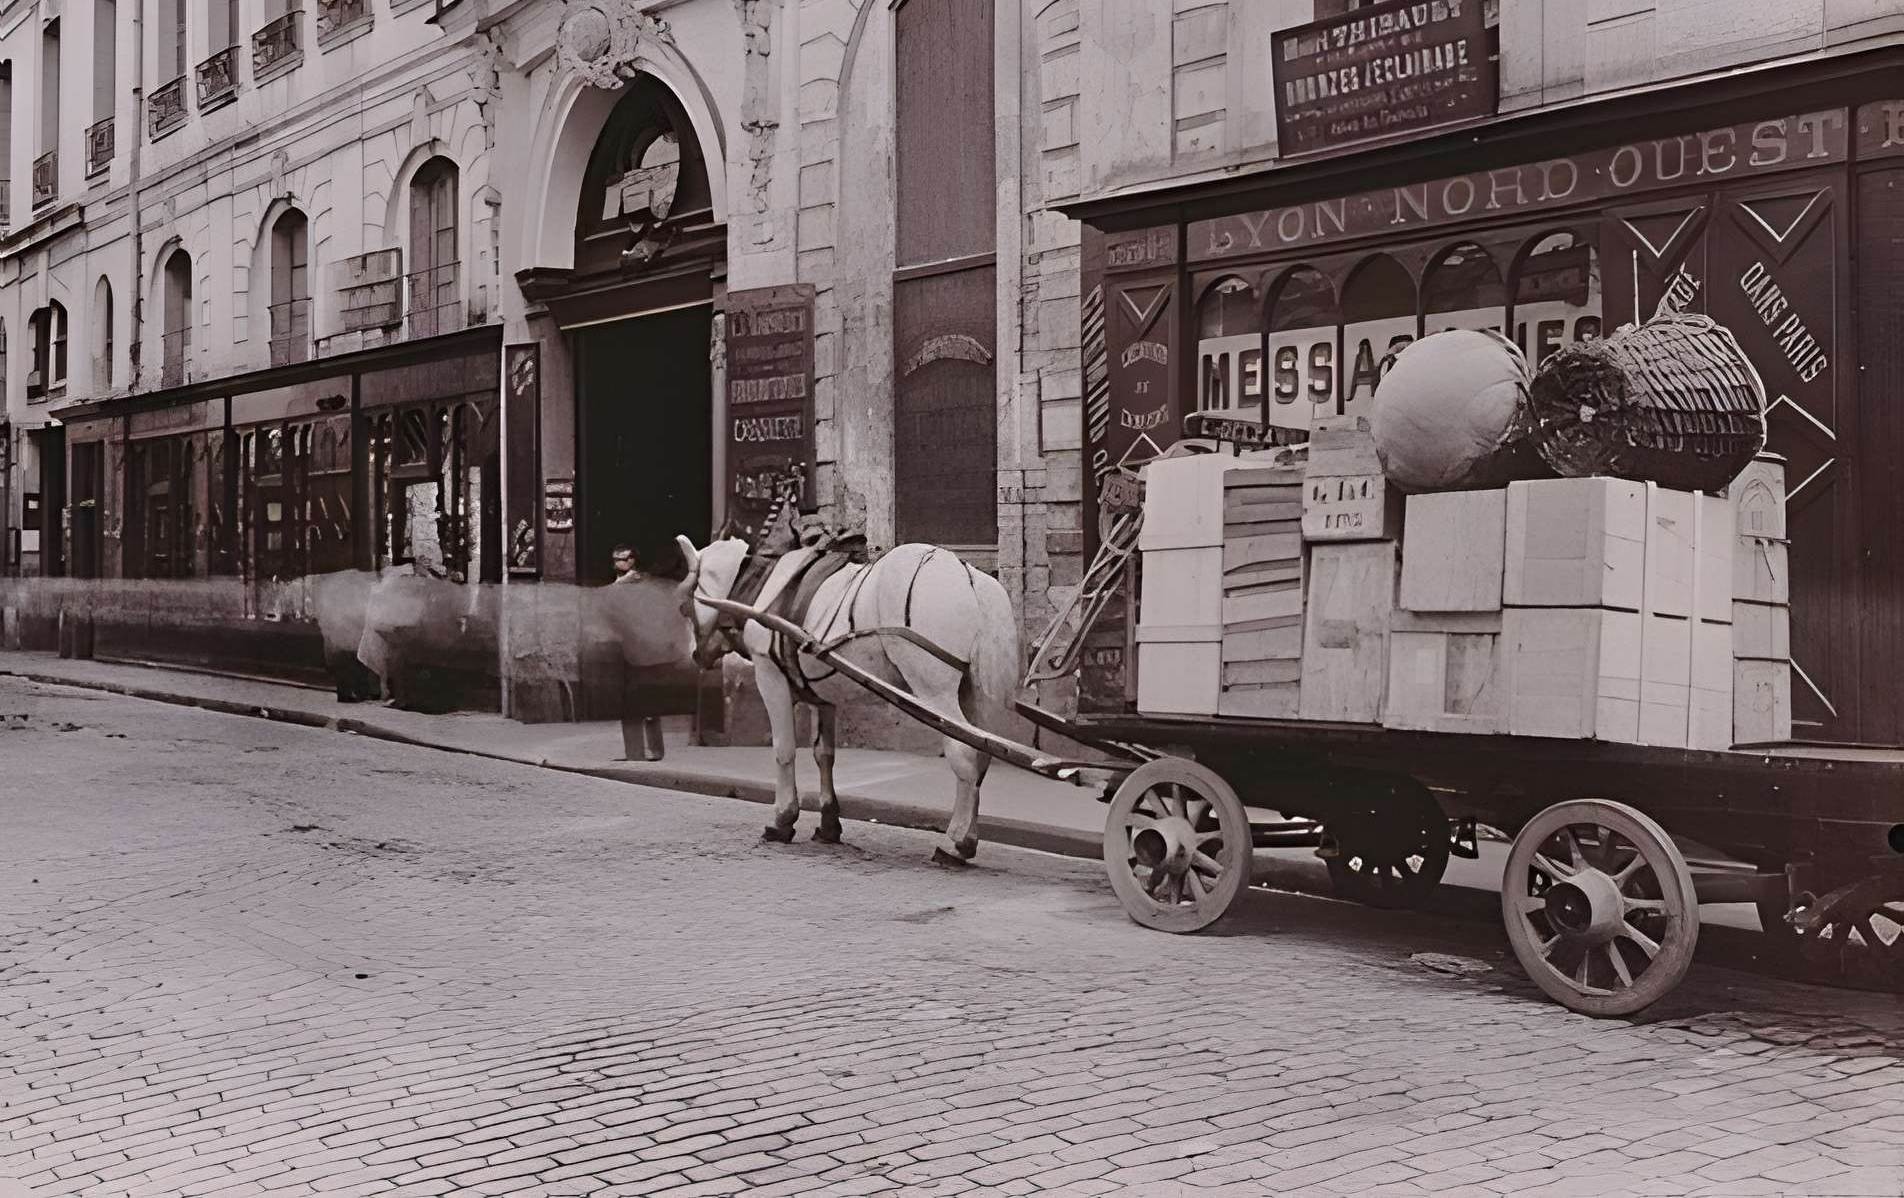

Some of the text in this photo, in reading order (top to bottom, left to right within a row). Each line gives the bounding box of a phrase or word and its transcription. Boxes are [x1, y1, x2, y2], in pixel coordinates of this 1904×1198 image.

[1208, 198, 1347, 253] LYON
[1609, 108, 1843, 188] OUEST
[1740, 261, 1827, 383] DANS PARIS
